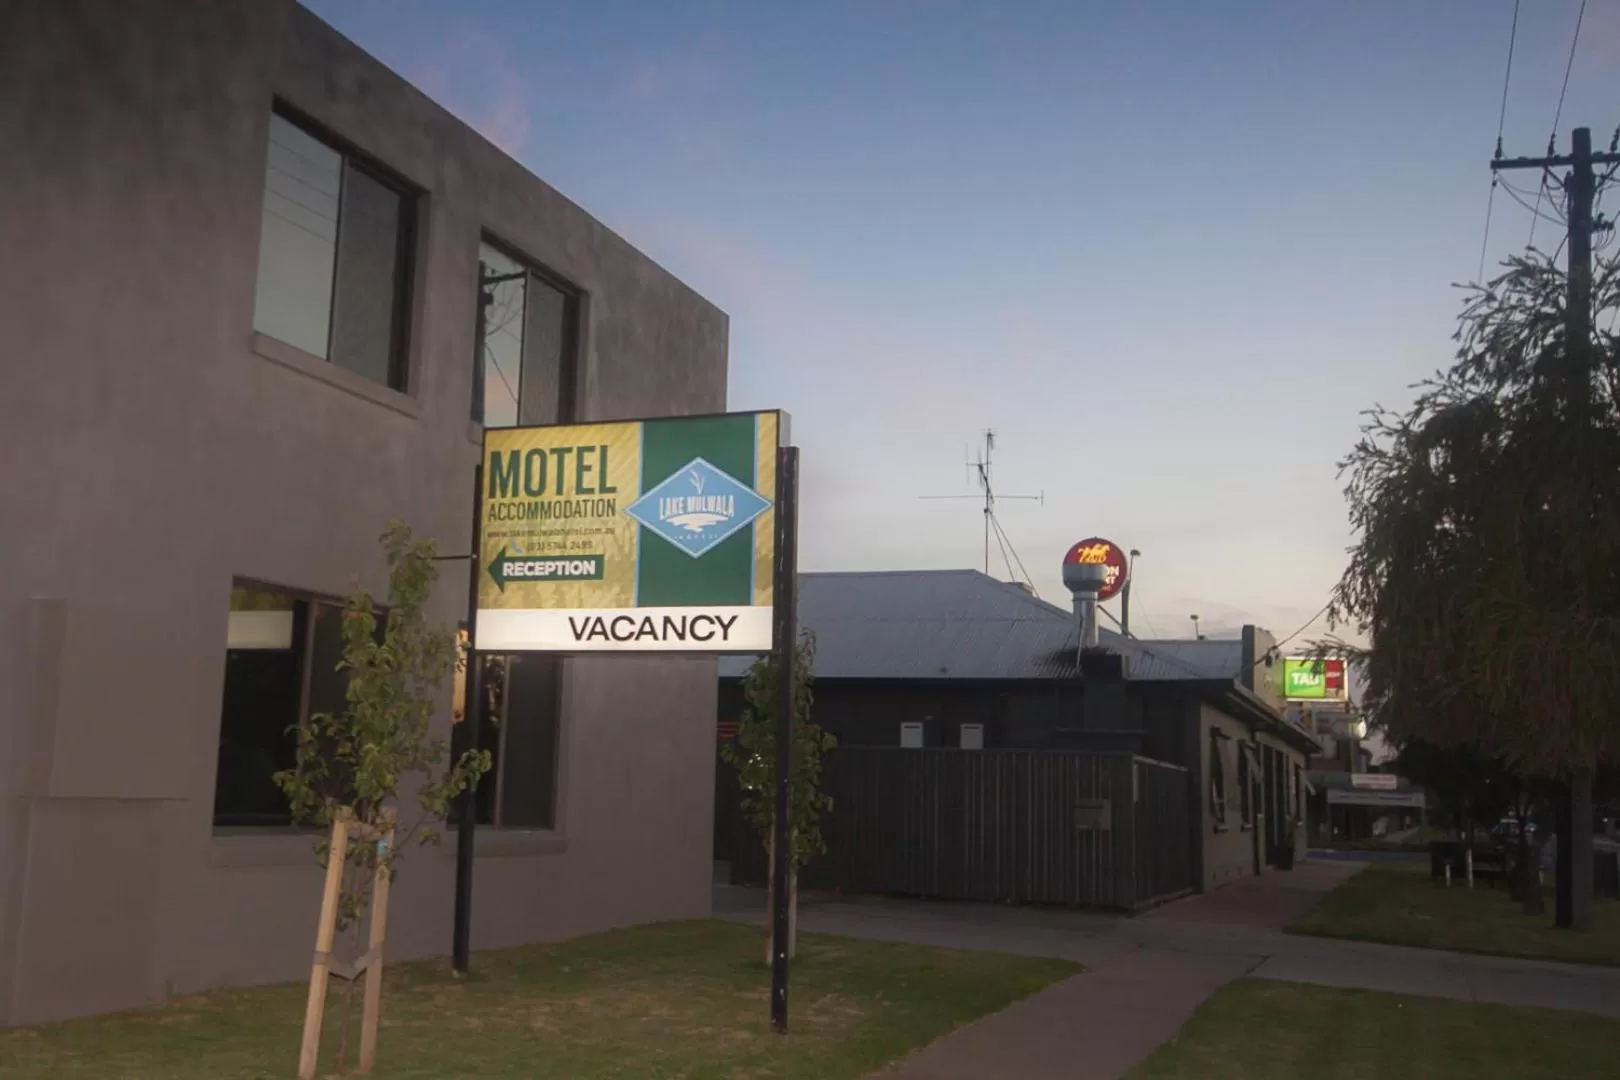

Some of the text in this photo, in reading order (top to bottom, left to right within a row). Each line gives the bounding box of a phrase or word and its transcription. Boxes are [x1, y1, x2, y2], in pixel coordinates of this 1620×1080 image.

[488, 445, 618, 499] MOTEL
[487, 498, 617, 521] ACCOMMODATION
[660, 496, 684, 520] LAKE
[502, 560, 596, 577] RECEPTION
[568, 614, 739, 642] VACANCY
